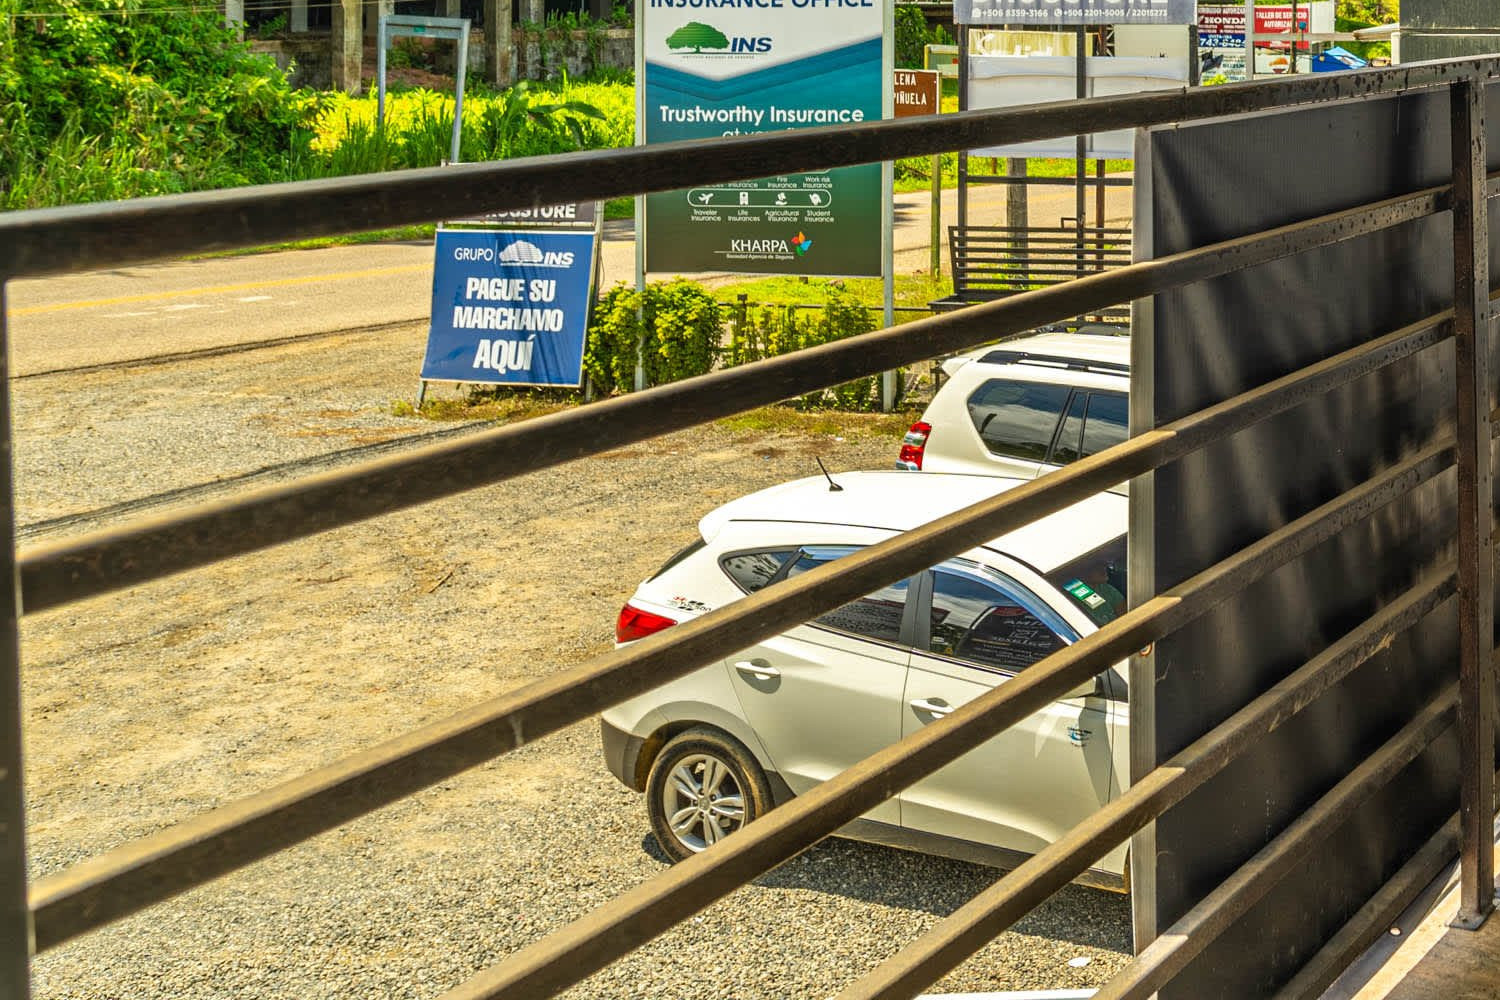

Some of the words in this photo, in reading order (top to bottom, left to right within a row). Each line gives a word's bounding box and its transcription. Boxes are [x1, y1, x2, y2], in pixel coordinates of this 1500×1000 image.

[731, 37, 773, 53] INS
[660, 105, 765, 126] Trustworthy
[770, 106, 864, 123] Insurance
[454, 247, 494, 261] GRUPO
[543, 252, 575, 265] INS
[731, 239, 789, 253] KHARPA
[466, 277, 525, 301] PAGUE
[529, 279, 557, 303] SU
[452, 306, 564, 332] MARCHAMO
[472, 334, 537, 374] AQUÍ
